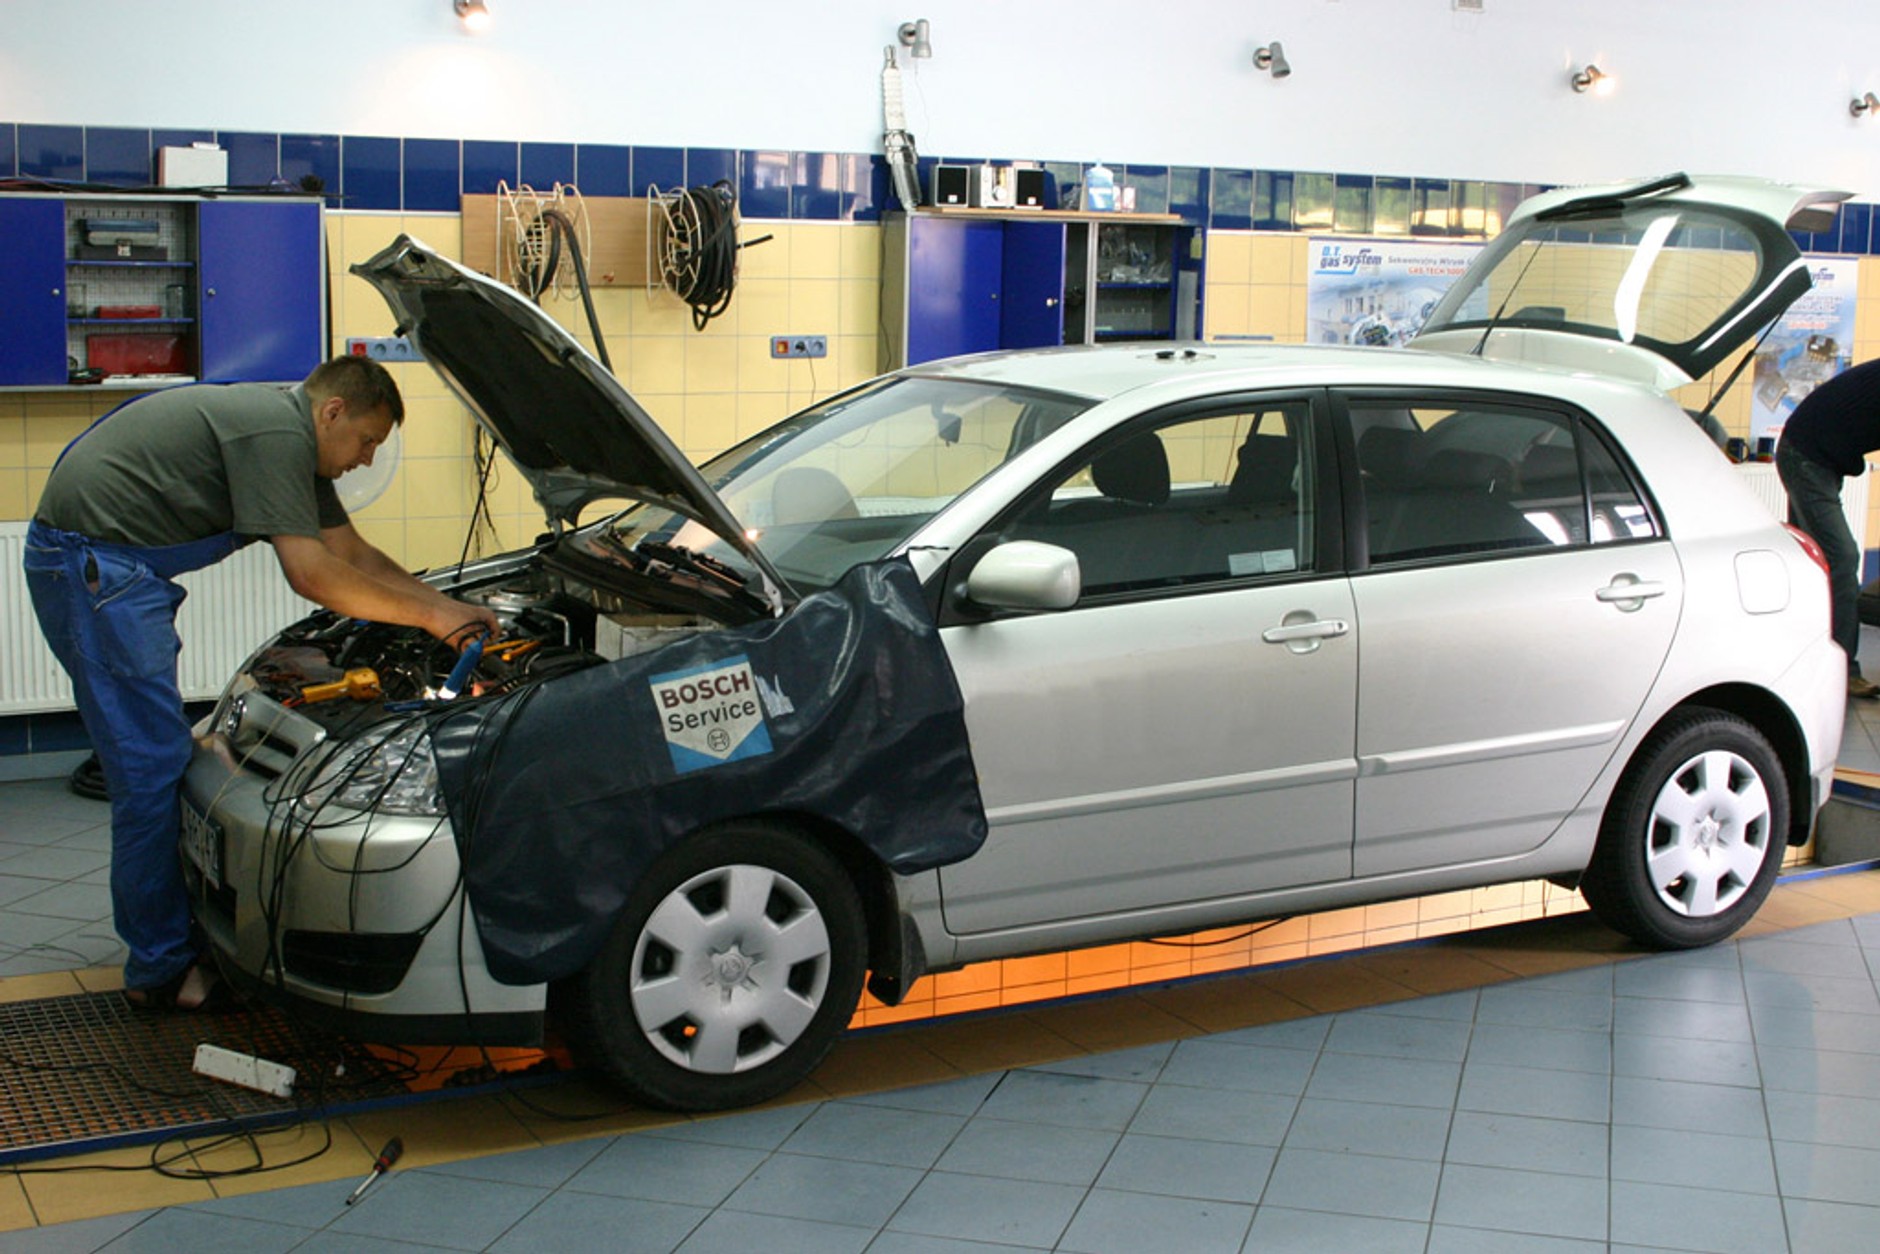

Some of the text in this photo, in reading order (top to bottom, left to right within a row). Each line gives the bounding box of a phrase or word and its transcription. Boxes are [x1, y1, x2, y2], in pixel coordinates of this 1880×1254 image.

[1320, 248, 1382, 269] gas system
[660, 670, 750, 709] BOSCH
[668, 701, 756, 733] Service
